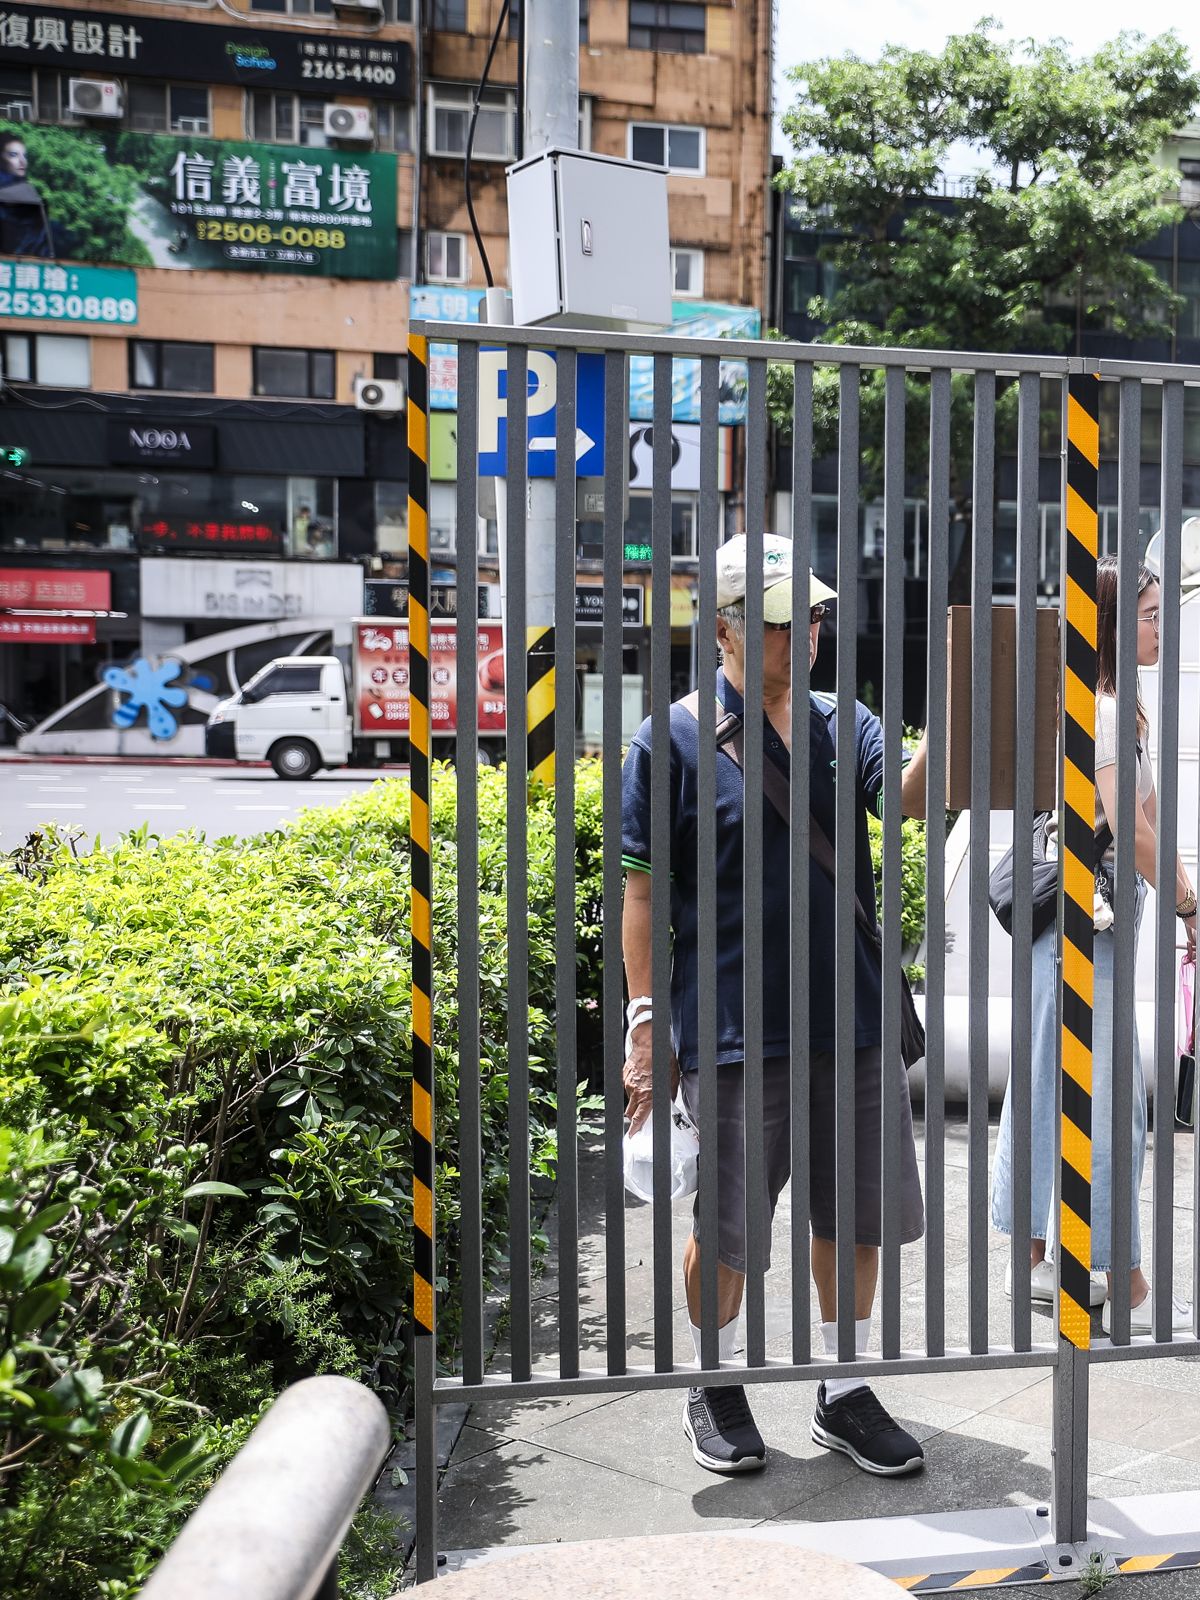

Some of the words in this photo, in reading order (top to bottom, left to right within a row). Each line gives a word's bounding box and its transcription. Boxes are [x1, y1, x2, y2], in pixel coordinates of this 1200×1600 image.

[0, 12, 143, 59] 復興設計
[302, 59, 396, 85] 2365-4400
[207, 219, 346, 249] 2506-0088
[0, 290, 137, 322] 25330889
[479, 350, 556, 453] P
